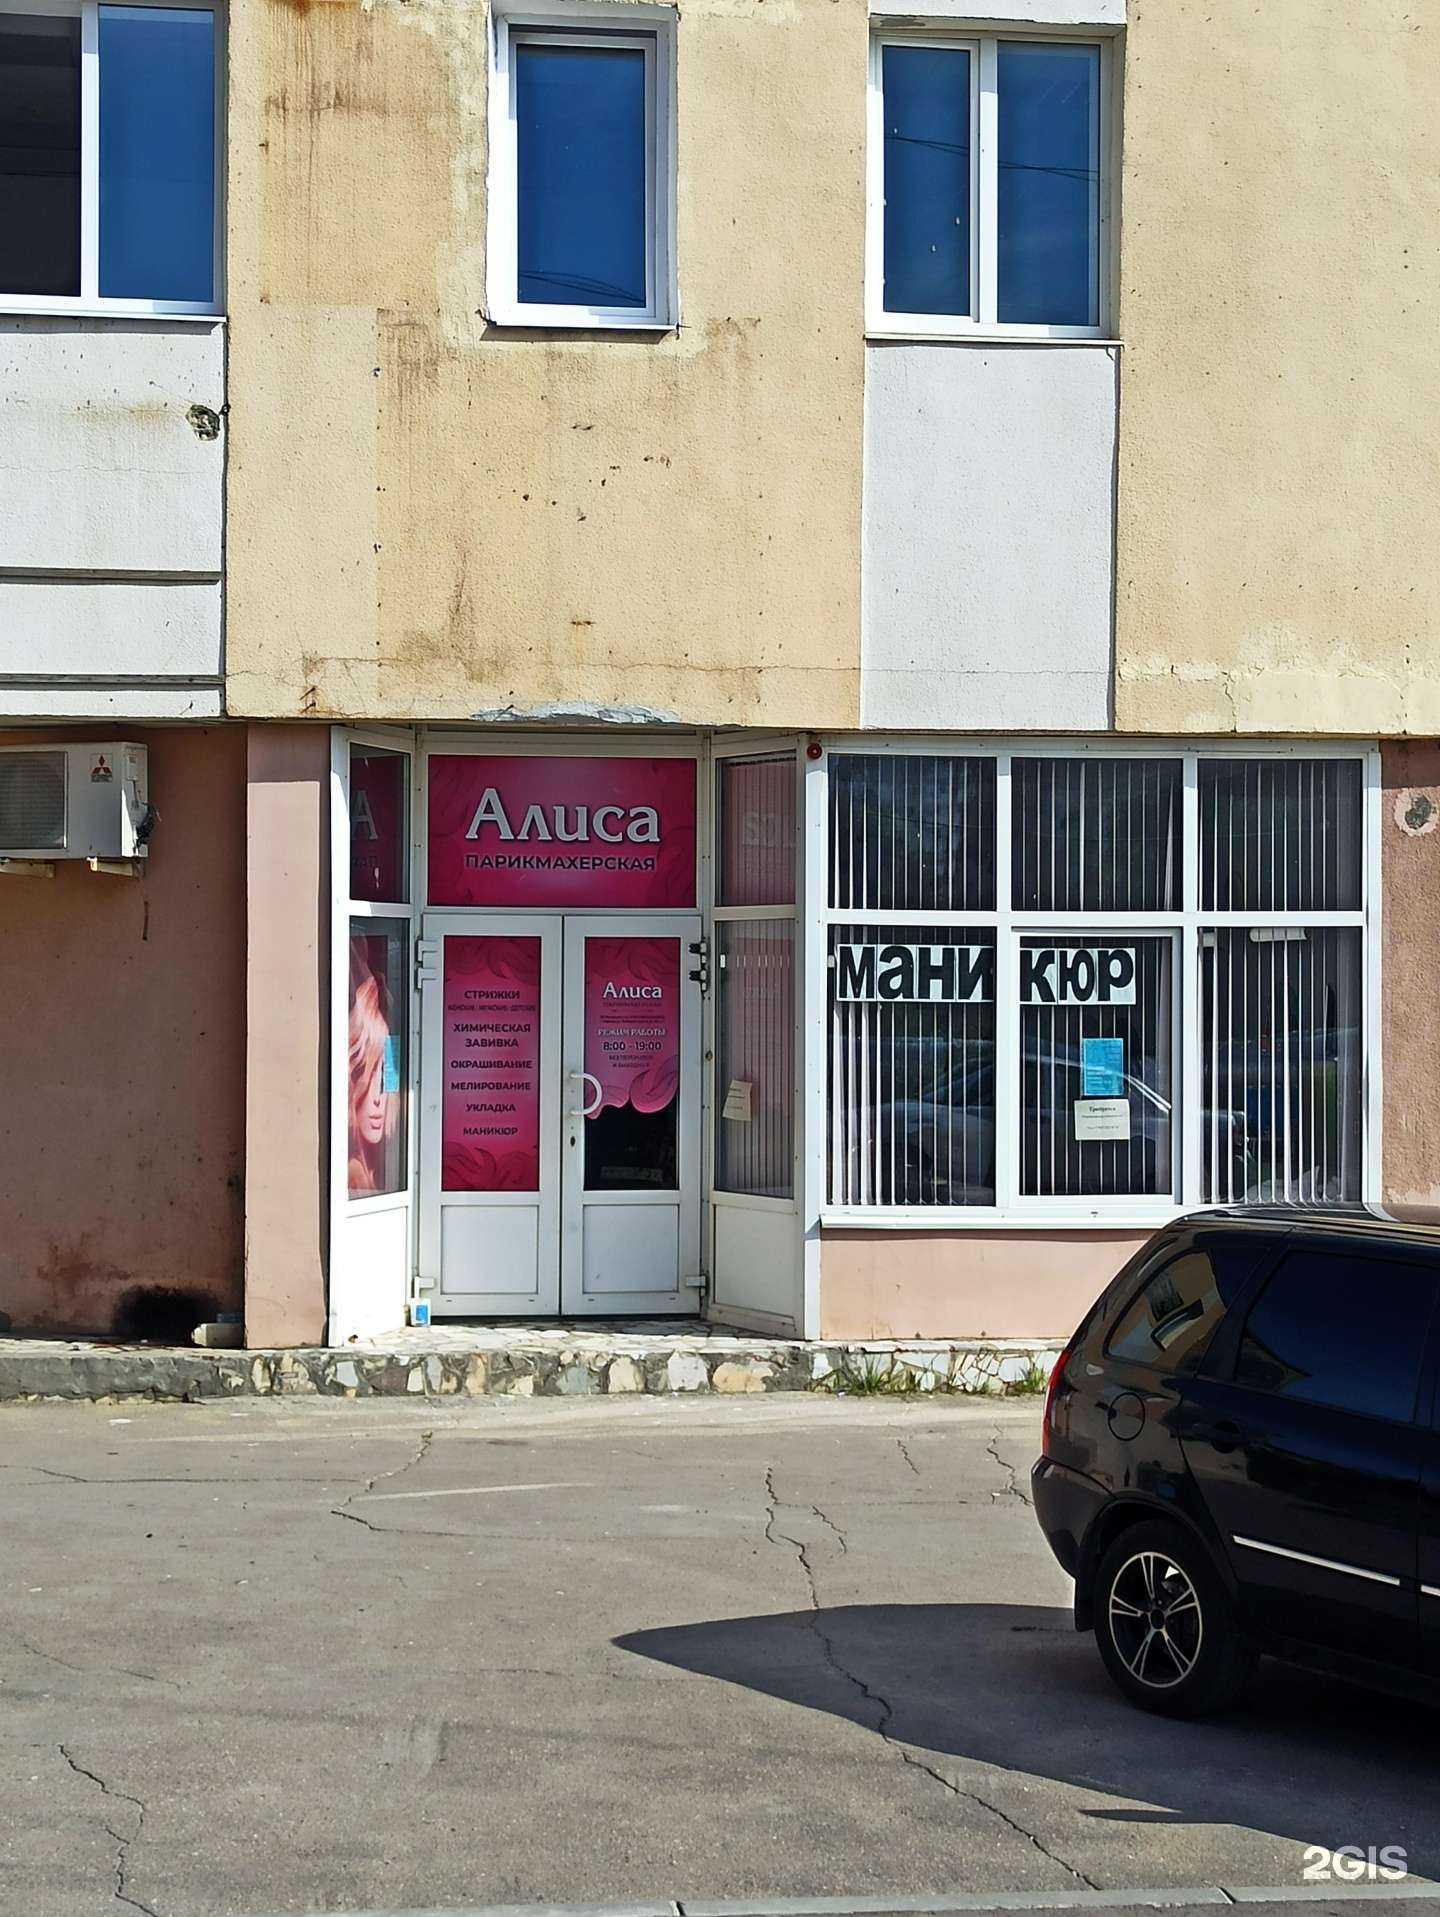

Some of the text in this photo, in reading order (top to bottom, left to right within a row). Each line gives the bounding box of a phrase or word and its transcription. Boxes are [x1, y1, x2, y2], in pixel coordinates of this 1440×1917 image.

[464, 787, 661, 843] Алиса
[464, 854, 656, 871] ПАРИКМАХЕРСКАЯ
[464, 990, 520, 1000] СТРИЖКИ
[603, 981, 662, 999] Алиса
[453, 1023, 531, 1033] ХИМИЧЕСКАЯ
[465, 1038, 520, 1048] ЗАВИВКА
[603, 1041, 626, 1051] 8:00
[635, 1041, 662, 1051] 19:00
[450, 1060, 533, 1069] ОКРАШИВАНИЕ
[450, 1081, 531, 1090] МЕЛИРОВАНИЕ
[466, 1103, 516, 1113] УКЛАДКА
[463, 1127, 519, 1136] МАНИКЮР
